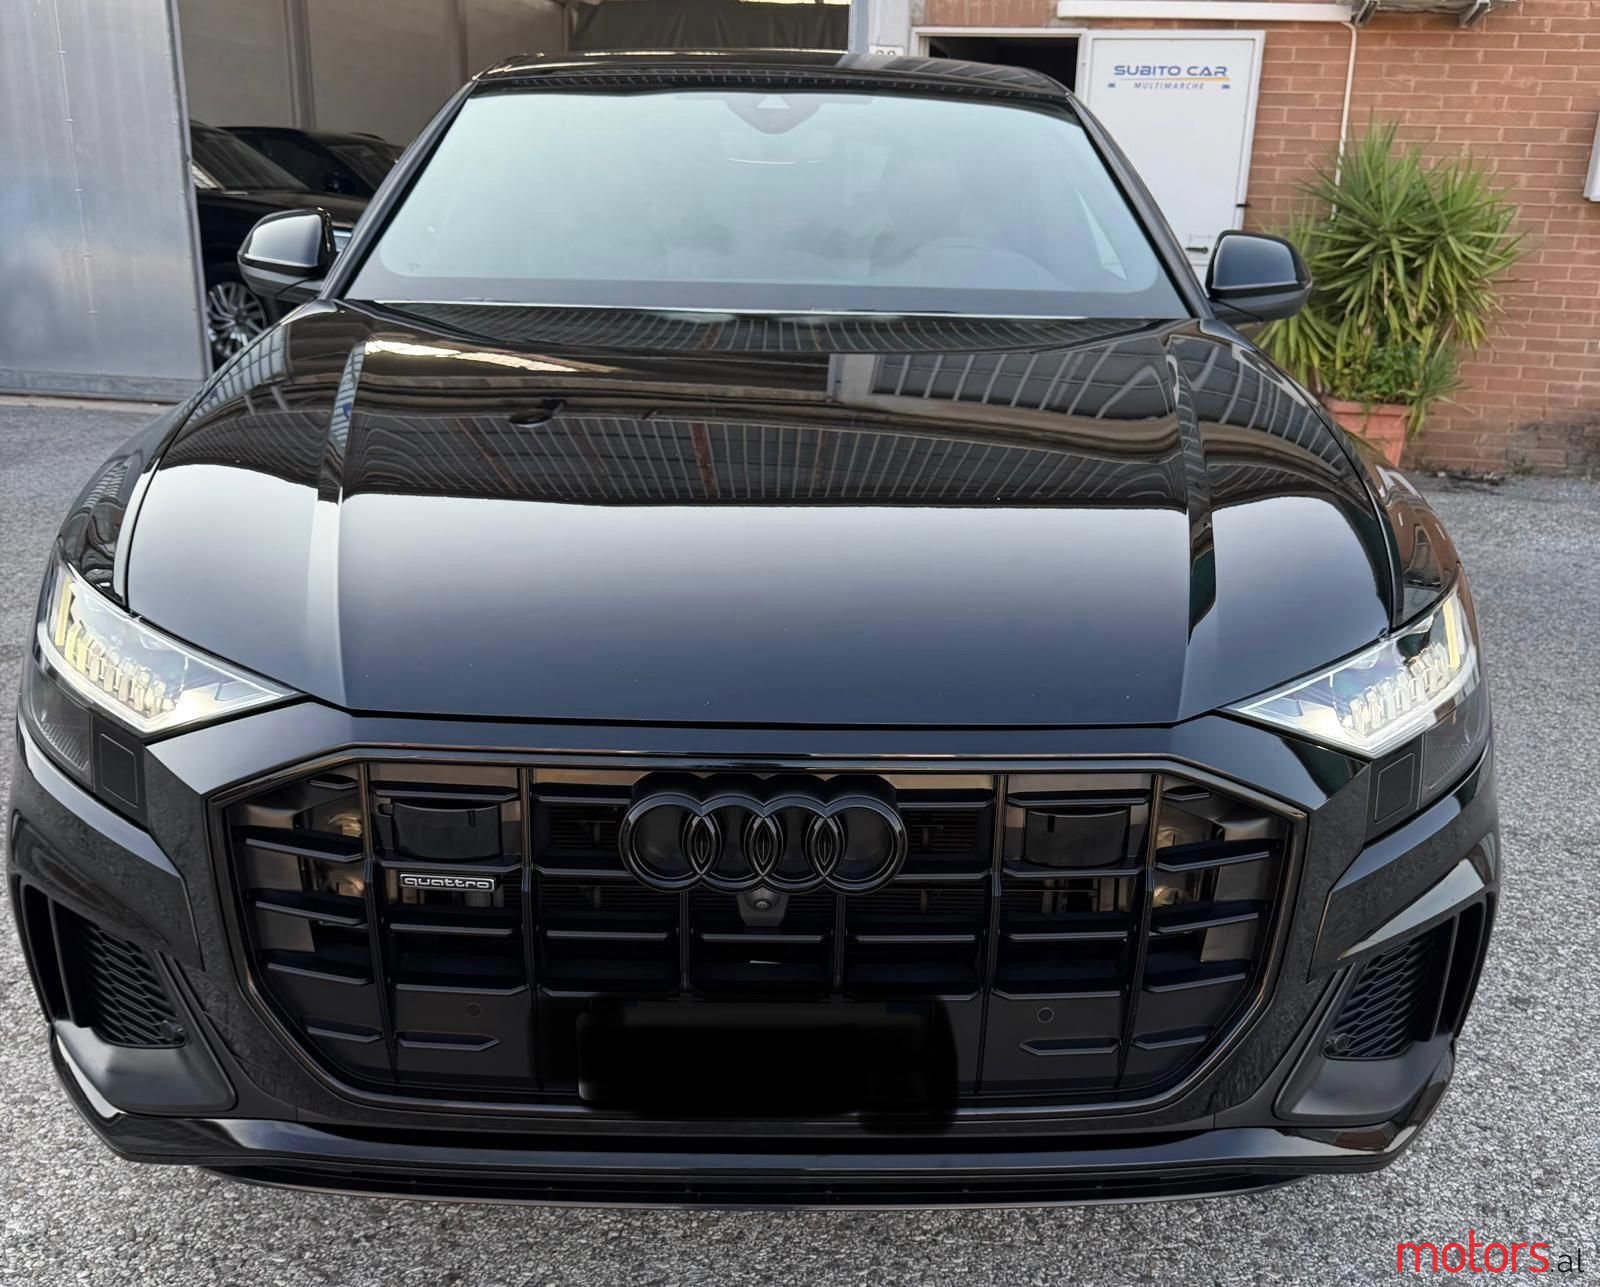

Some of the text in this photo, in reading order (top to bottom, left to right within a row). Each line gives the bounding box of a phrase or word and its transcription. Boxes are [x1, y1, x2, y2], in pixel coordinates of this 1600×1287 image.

[1113, 65, 1228, 77] SUBITO CAR
[1133, 81, 1205, 90] MULTIMARCHE
[404, 877, 490, 889] quattro
